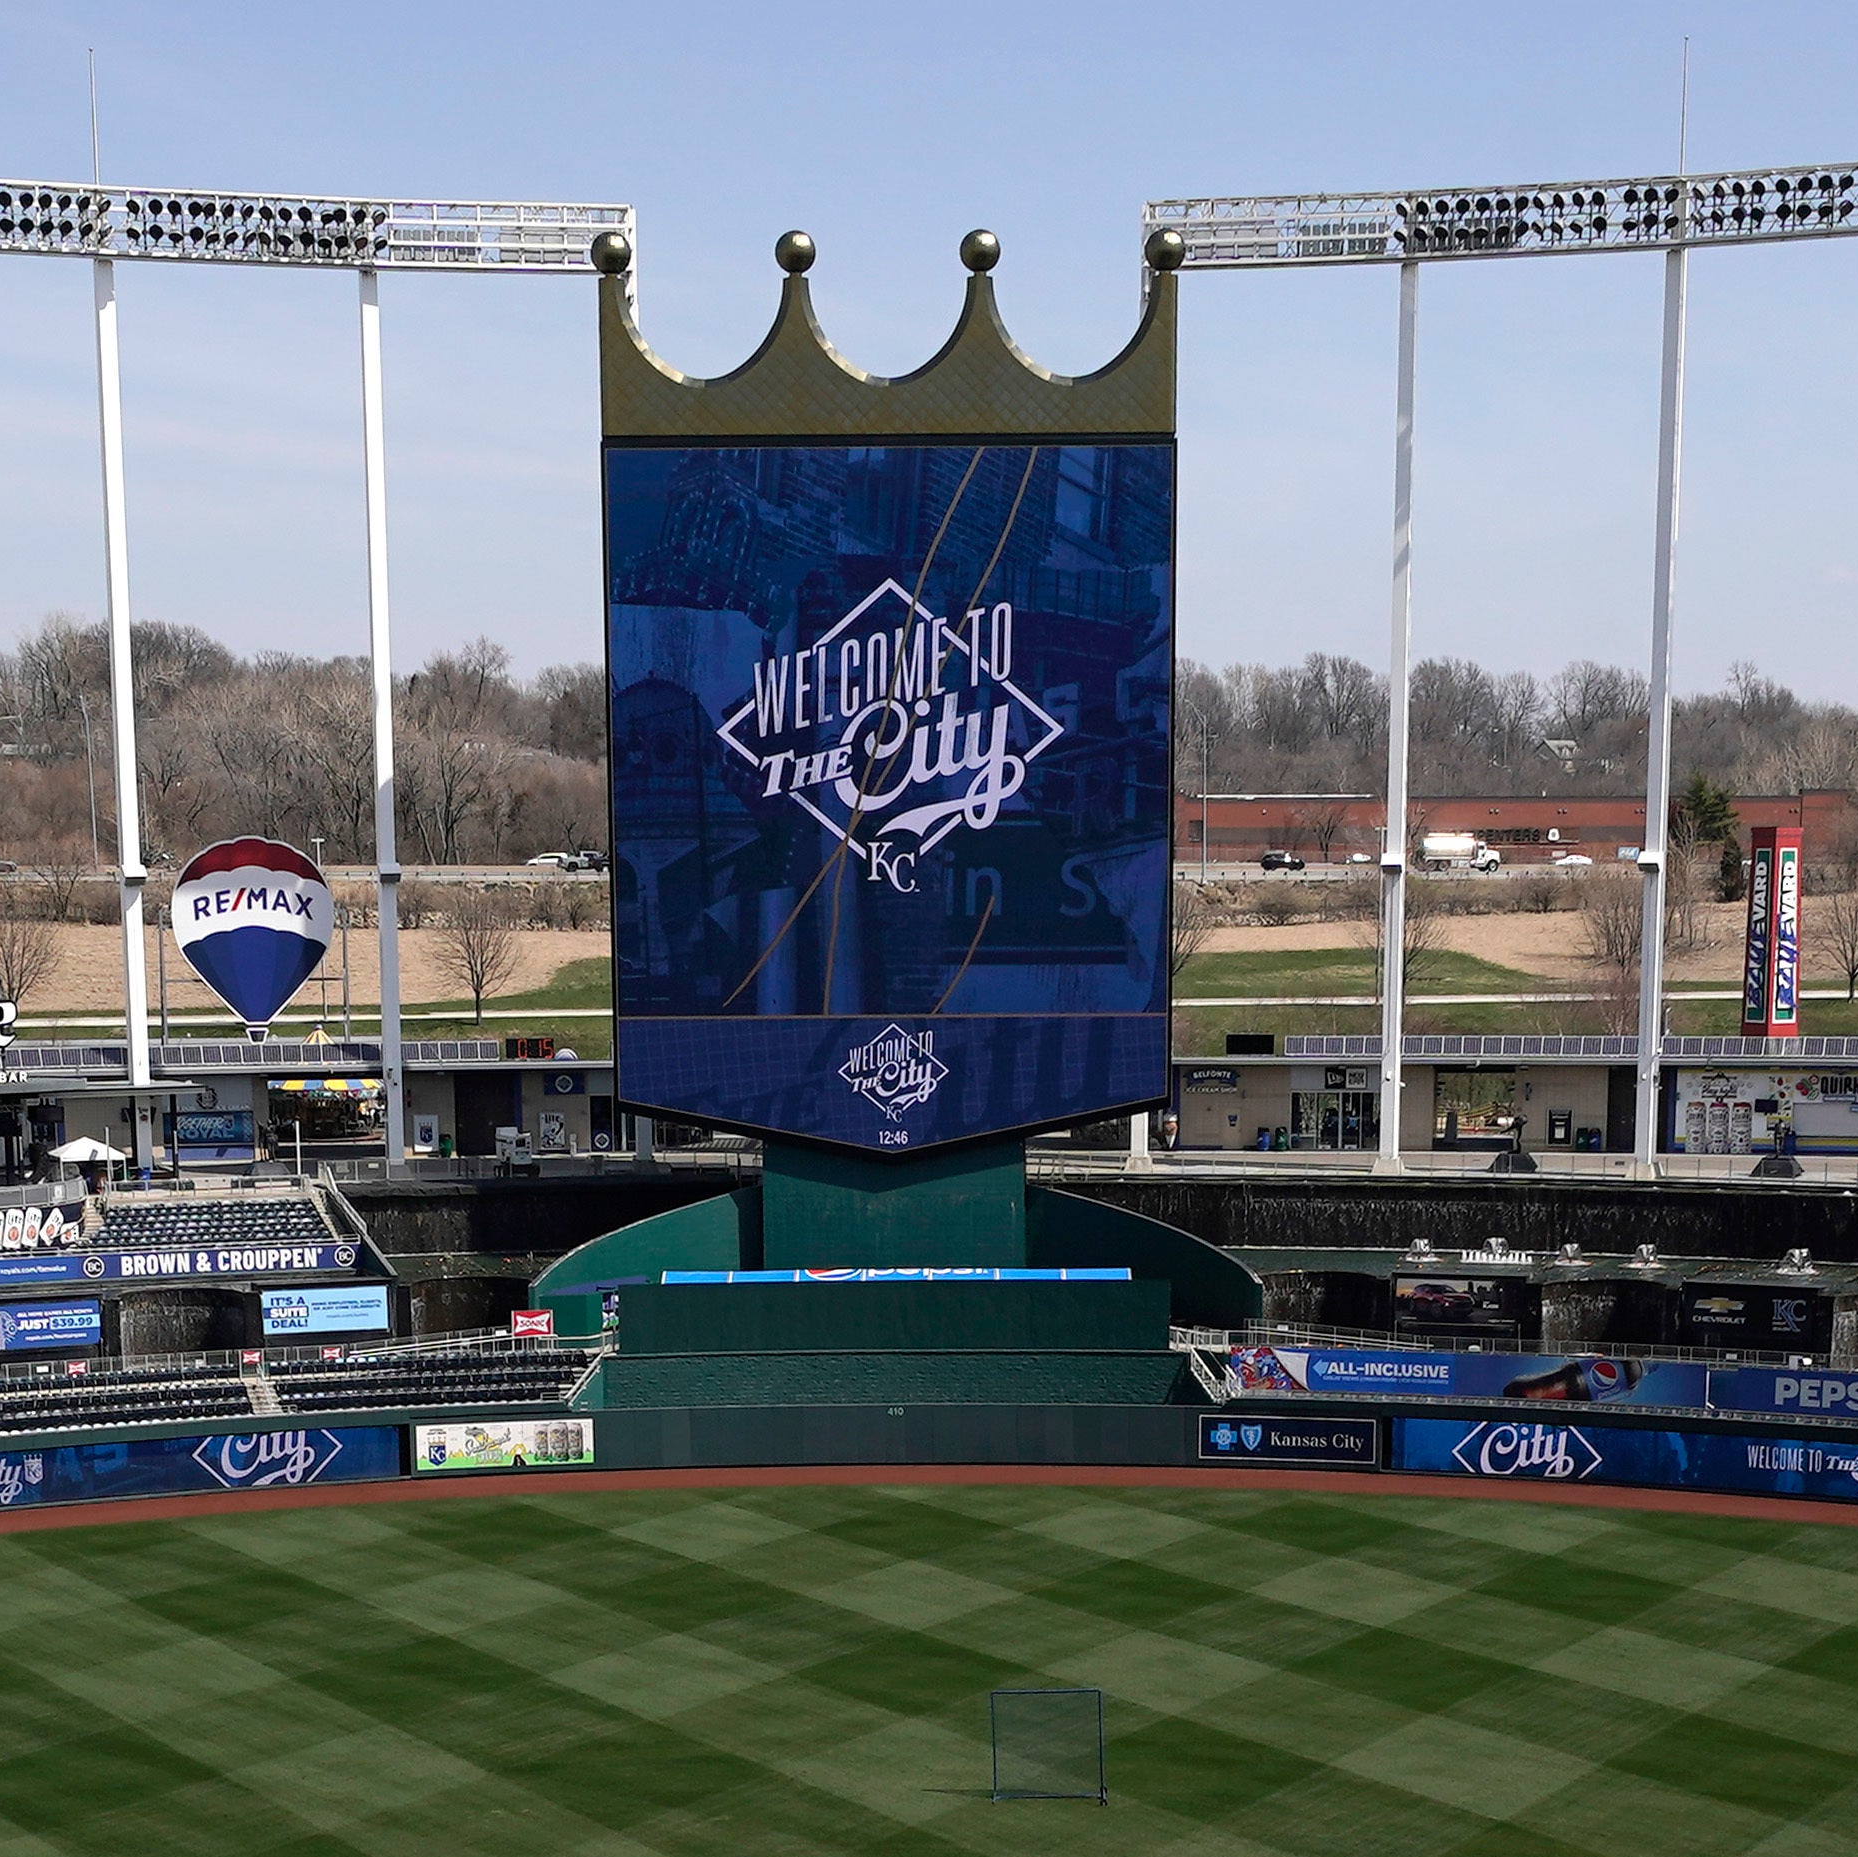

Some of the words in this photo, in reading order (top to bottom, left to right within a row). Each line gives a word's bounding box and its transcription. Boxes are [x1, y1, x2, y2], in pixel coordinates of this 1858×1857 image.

[752, 616, 946, 738] WELCOME
[967, 601, 1013, 683] TO
[758, 744, 855, 799] THE
[836, 695, 1027, 837] City
[867, 841, 916, 893] KC
[193, 887, 314, 921] RE/MAX
[849, 1035, 913, 1074] WELCOME
[918, 1030, 933, 1058] TO
[852, 1075, 883, 1093] THE
[875, 1058, 937, 1105] City
[1193, 1068, 1231, 1080] BELFONTE
[886, 1105, 903, 1123] KC
[879, 1130, 909, 1145] 12:46
[121, 1254, 191, 1276] BROWN
[196, 1252, 212, 1273] &
[217, 1248, 317, 1272] CROUPPEN
[270, 1297, 293, 1306] IT'S
[296, 1296, 305, 1305] A
[270, 1306, 308, 1318] SUITE
[17, 1320, 49, 1331] JUST
[51, 1316, 93, 1327] $39.99
[271, 1319, 308, 1328] DEAL!
[519, 1319, 546, 1328] SONIC
[1692, 1314, 1746, 1325] CHEVROLET
[1772, 1299, 1807, 1333] KC
[1327, 1361, 1449, 1379] ALL-INCLUSIVE
[1269, 1430, 1328, 1449] Kansas
[1332, 1433, 1365, 1453] City
[1479, 1421, 1575, 1477] City
[219, 1430, 321, 1486] City
[1747, 1444, 1803, 1472] WELCOME
[1807, 1446, 1822, 1473] TO
